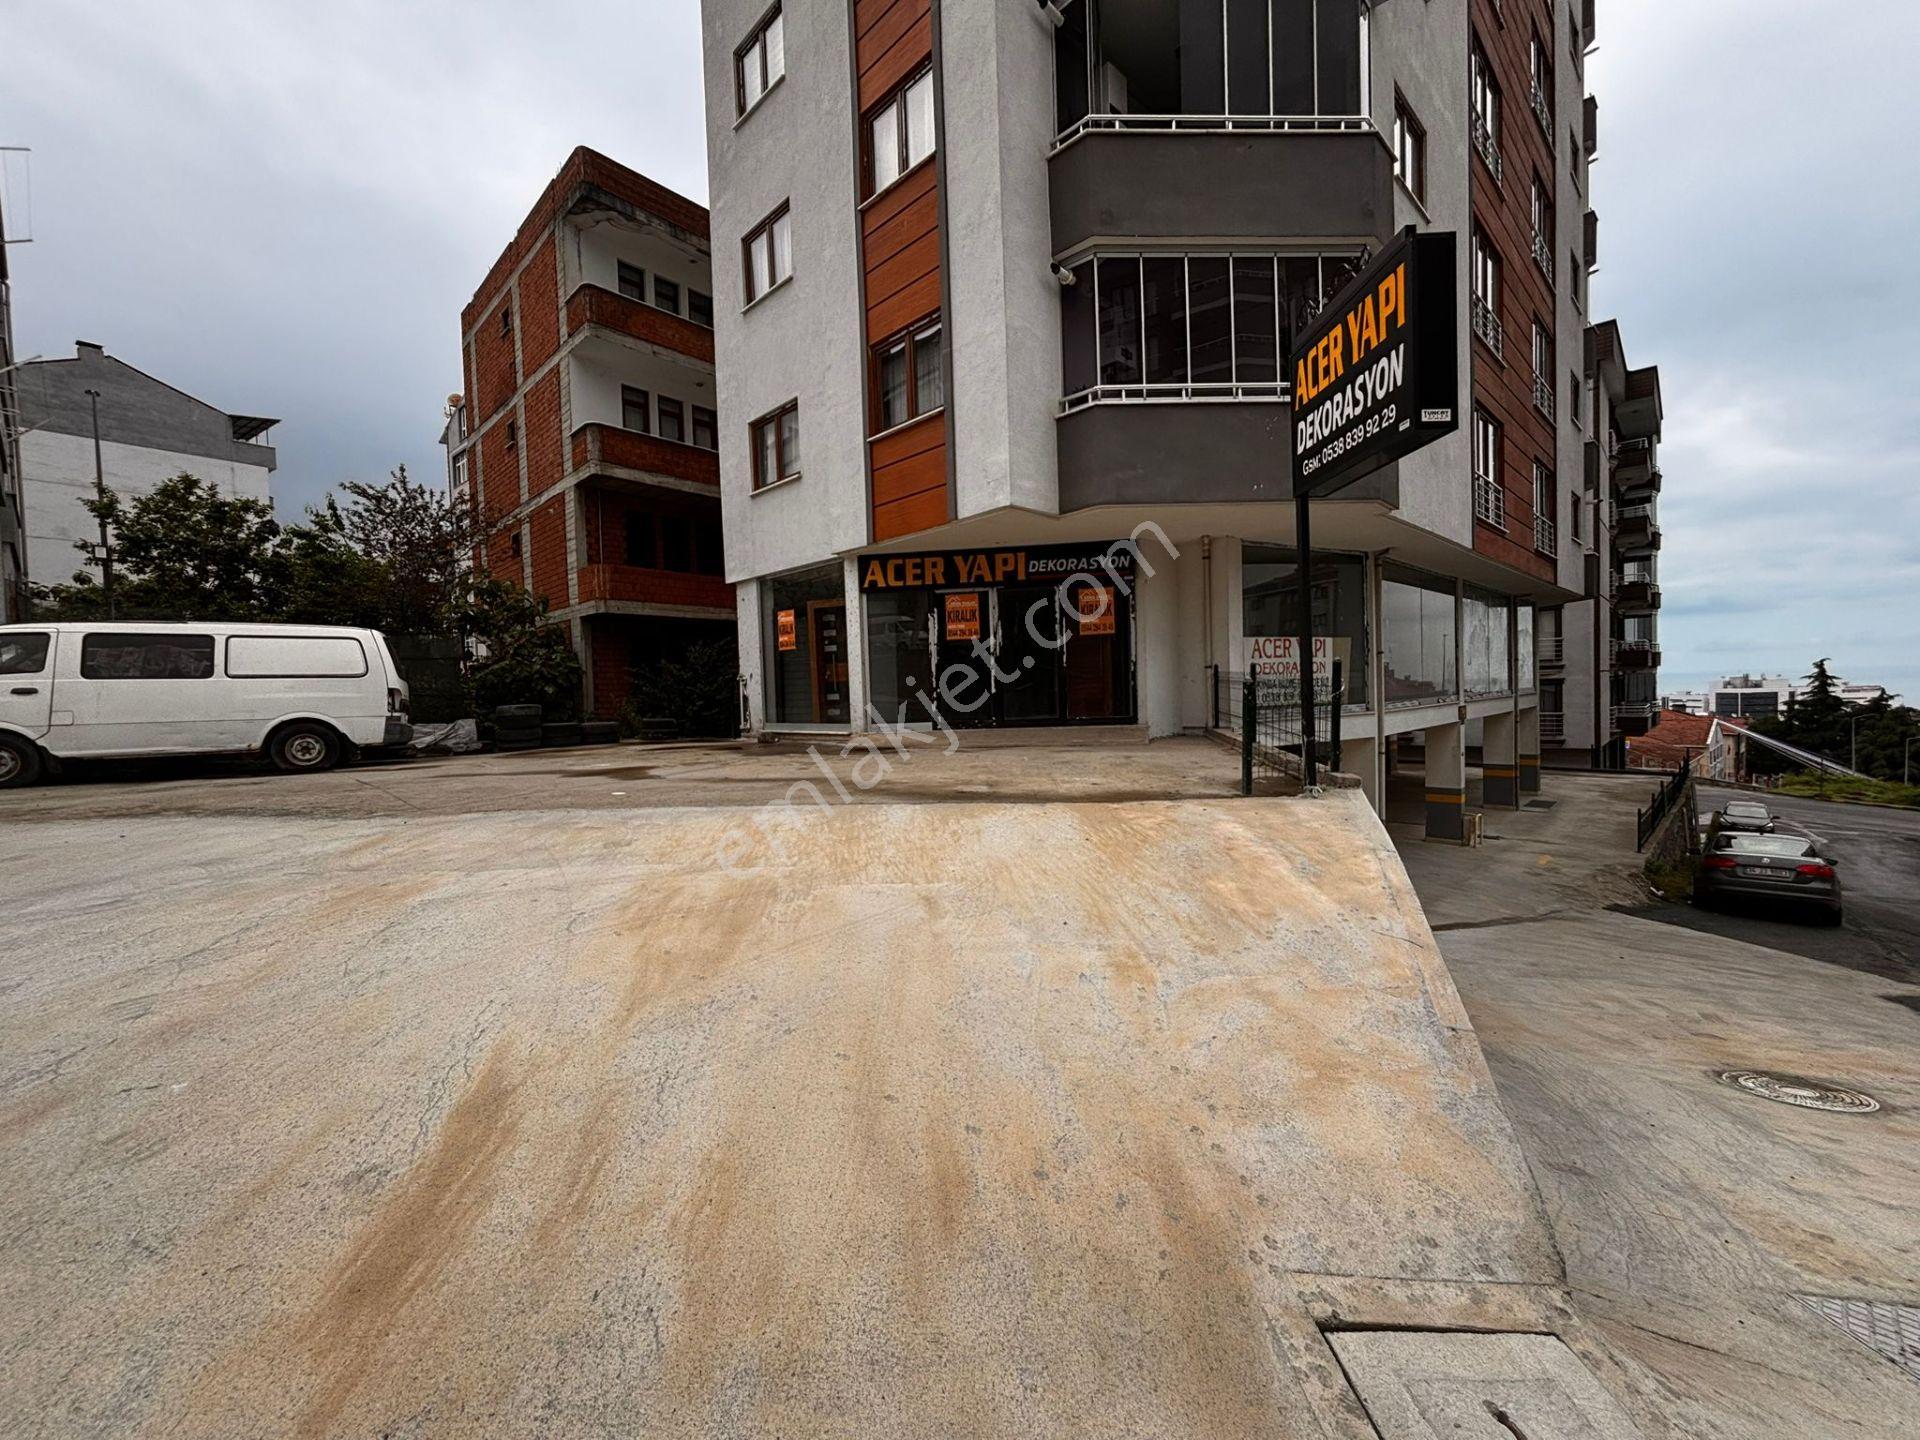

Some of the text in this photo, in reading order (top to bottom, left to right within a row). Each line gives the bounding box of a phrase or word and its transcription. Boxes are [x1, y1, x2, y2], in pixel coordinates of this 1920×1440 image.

[1295, 262, 1406, 411] ACER YAPI
[1297, 343, 1405, 455] DEKORASYON
[1322, 437, 1344, 464] 0538
[1345, 424, 1364, 450] 839
[1366, 414, 1380, 437] 92
[1381, 403, 1396, 429] 29
[863, 557, 945, 588] ACER
[954, 552, 1026, 583] YAPI
[1252, 638, 1292, 659] ACER
